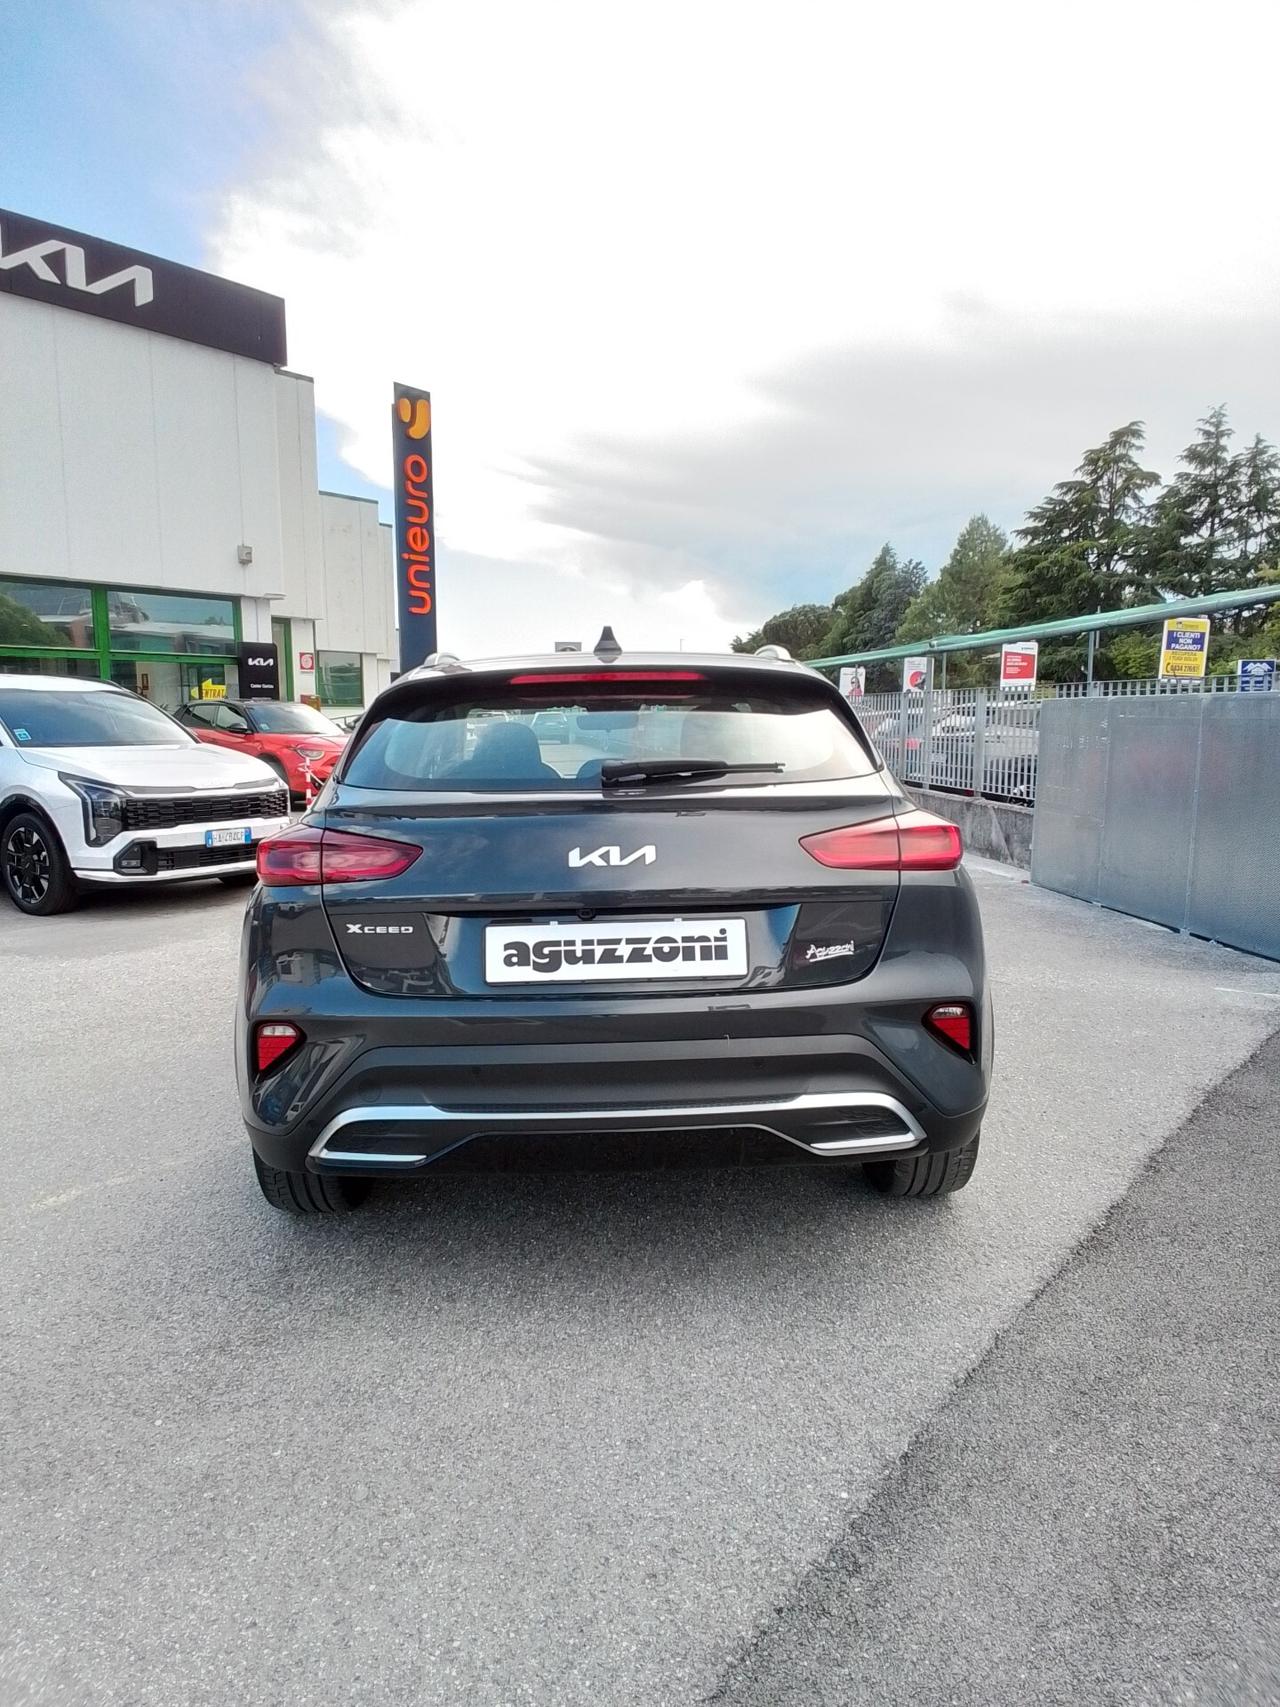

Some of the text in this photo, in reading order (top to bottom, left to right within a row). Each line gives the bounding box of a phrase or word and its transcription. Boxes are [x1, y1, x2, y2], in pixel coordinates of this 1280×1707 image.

[402, 453, 432, 615] unieuro
[247, 658, 274, 666] KIA
[568, 845, 656, 867] KIA
[503, 928, 728, 973] aguzzoni
